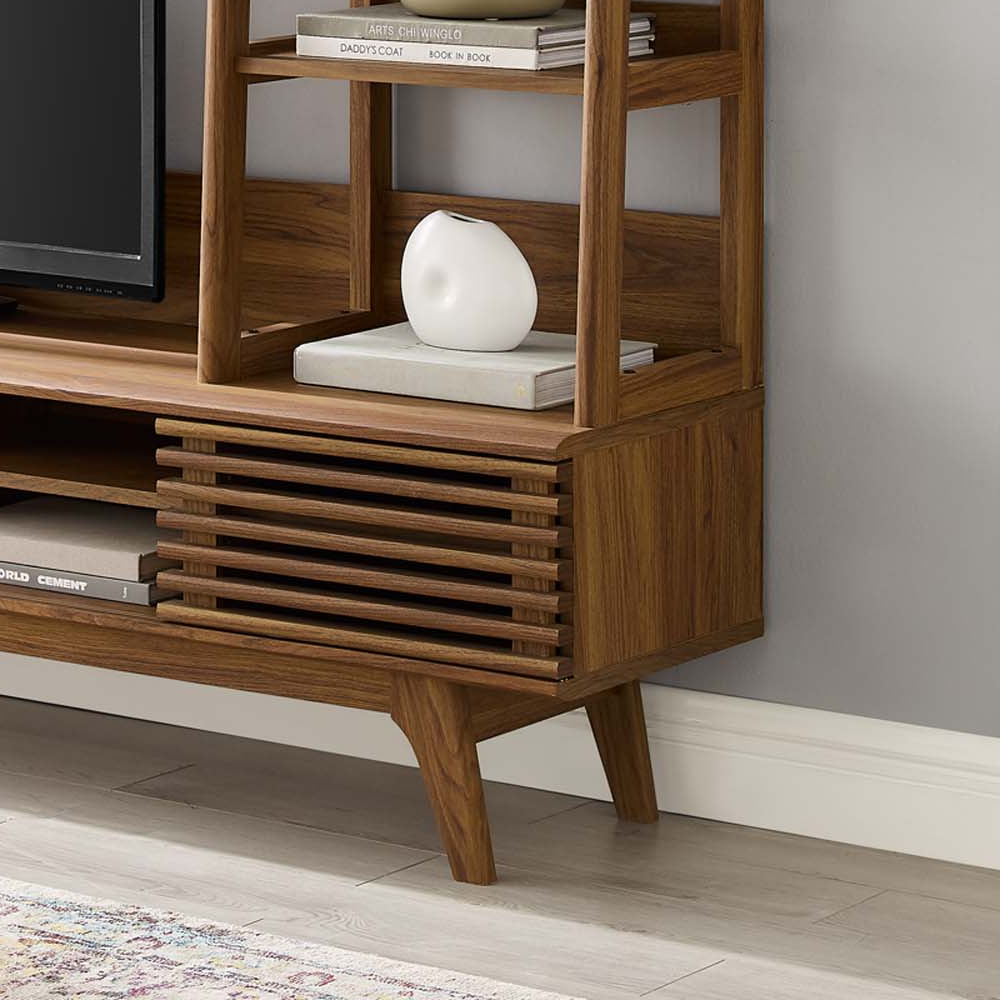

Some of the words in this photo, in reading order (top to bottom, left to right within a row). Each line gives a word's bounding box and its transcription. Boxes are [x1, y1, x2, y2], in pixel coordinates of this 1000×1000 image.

[368, 24, 394, 36] ARTS
[398, 26, 416, 37] CHI
[420, 28, 462, 40] WINGLO
[377, 46, 403, 57] COAT
[429, 49, 452, 60] BOOK
[455, 52, 465, 60] IN
[466, 53, 492, 63] BOOK
[37, 575, 88, 591] CEMENT
